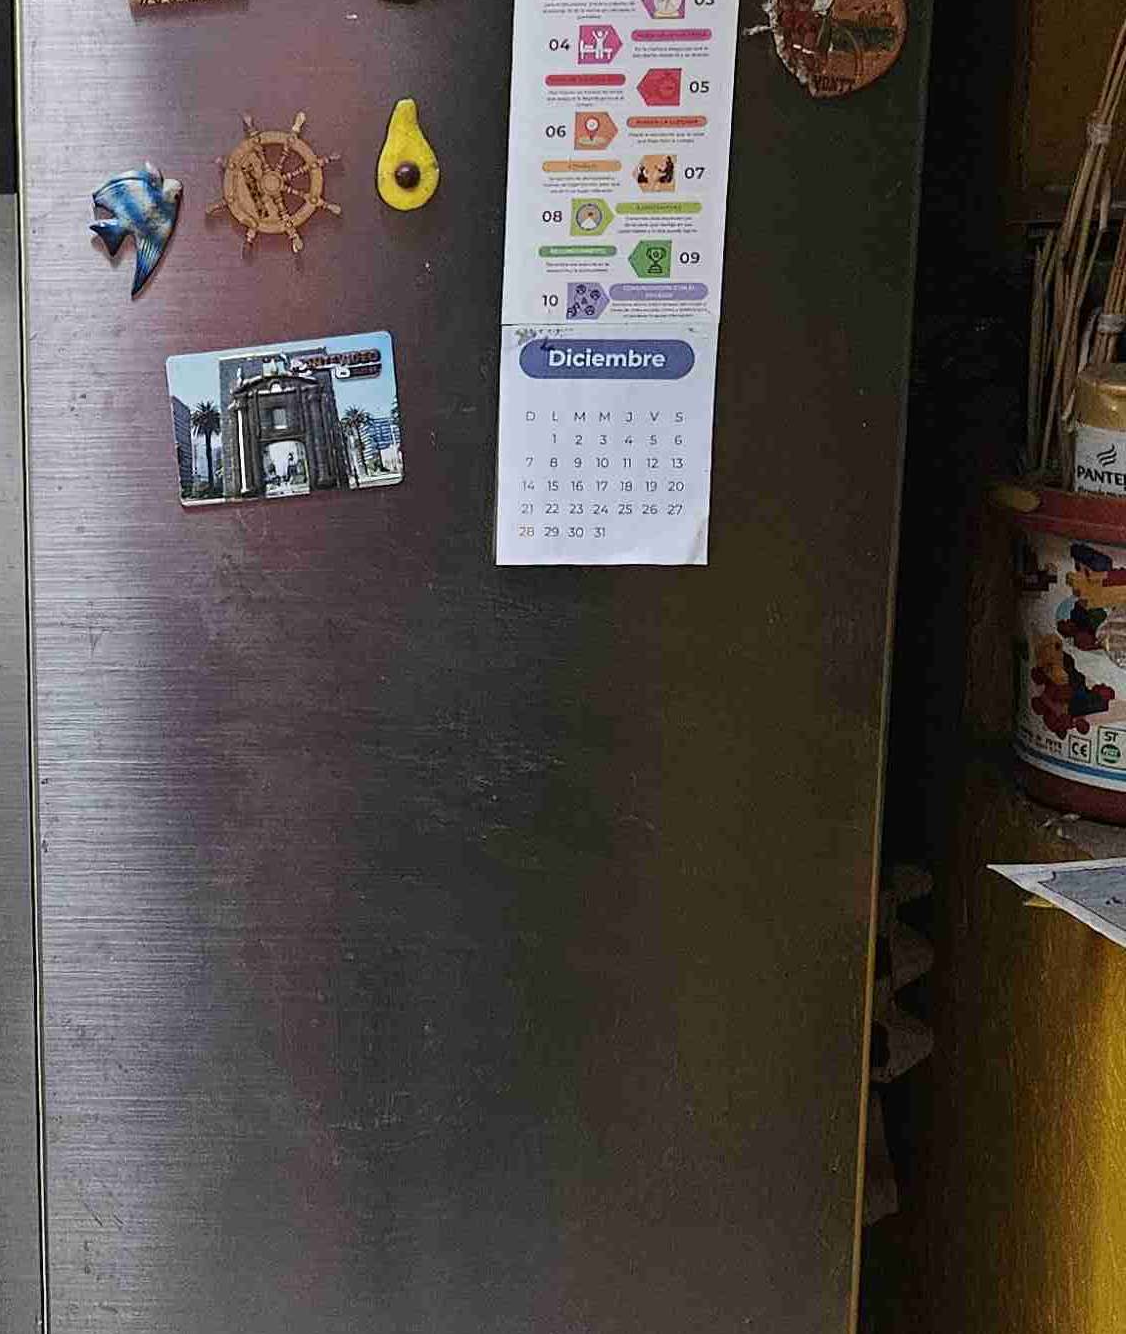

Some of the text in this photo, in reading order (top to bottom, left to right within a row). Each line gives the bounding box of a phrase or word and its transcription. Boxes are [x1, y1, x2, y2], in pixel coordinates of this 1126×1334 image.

[549, 38, 570, 52] 04
[689, 81, 710, 94] 05
[545, 125, 567, 138] 06
[684, 167, 705, 180] 07
[542, 210, 563, 223] 08
[679, 251, 700, 264] 09
[541, 294, 559, 307] 10
[548, 347, 666, 368] Diciembre
[525, 411, 684, 422] D L M M J V S
[552, 434, 683, 445] 1 2 3 4 5 6
[525, 457, 684, 469] 7 8 9 10 11 12 13
[1077, 465, 1126, 486] PANTE
[522, 481, 685, 492] 14 15 16 17 18 19 20
[521, 504, 683, 515] 21 22 23 24 25 26 27
[519, 527, 606, 538] 28 29 30 31
